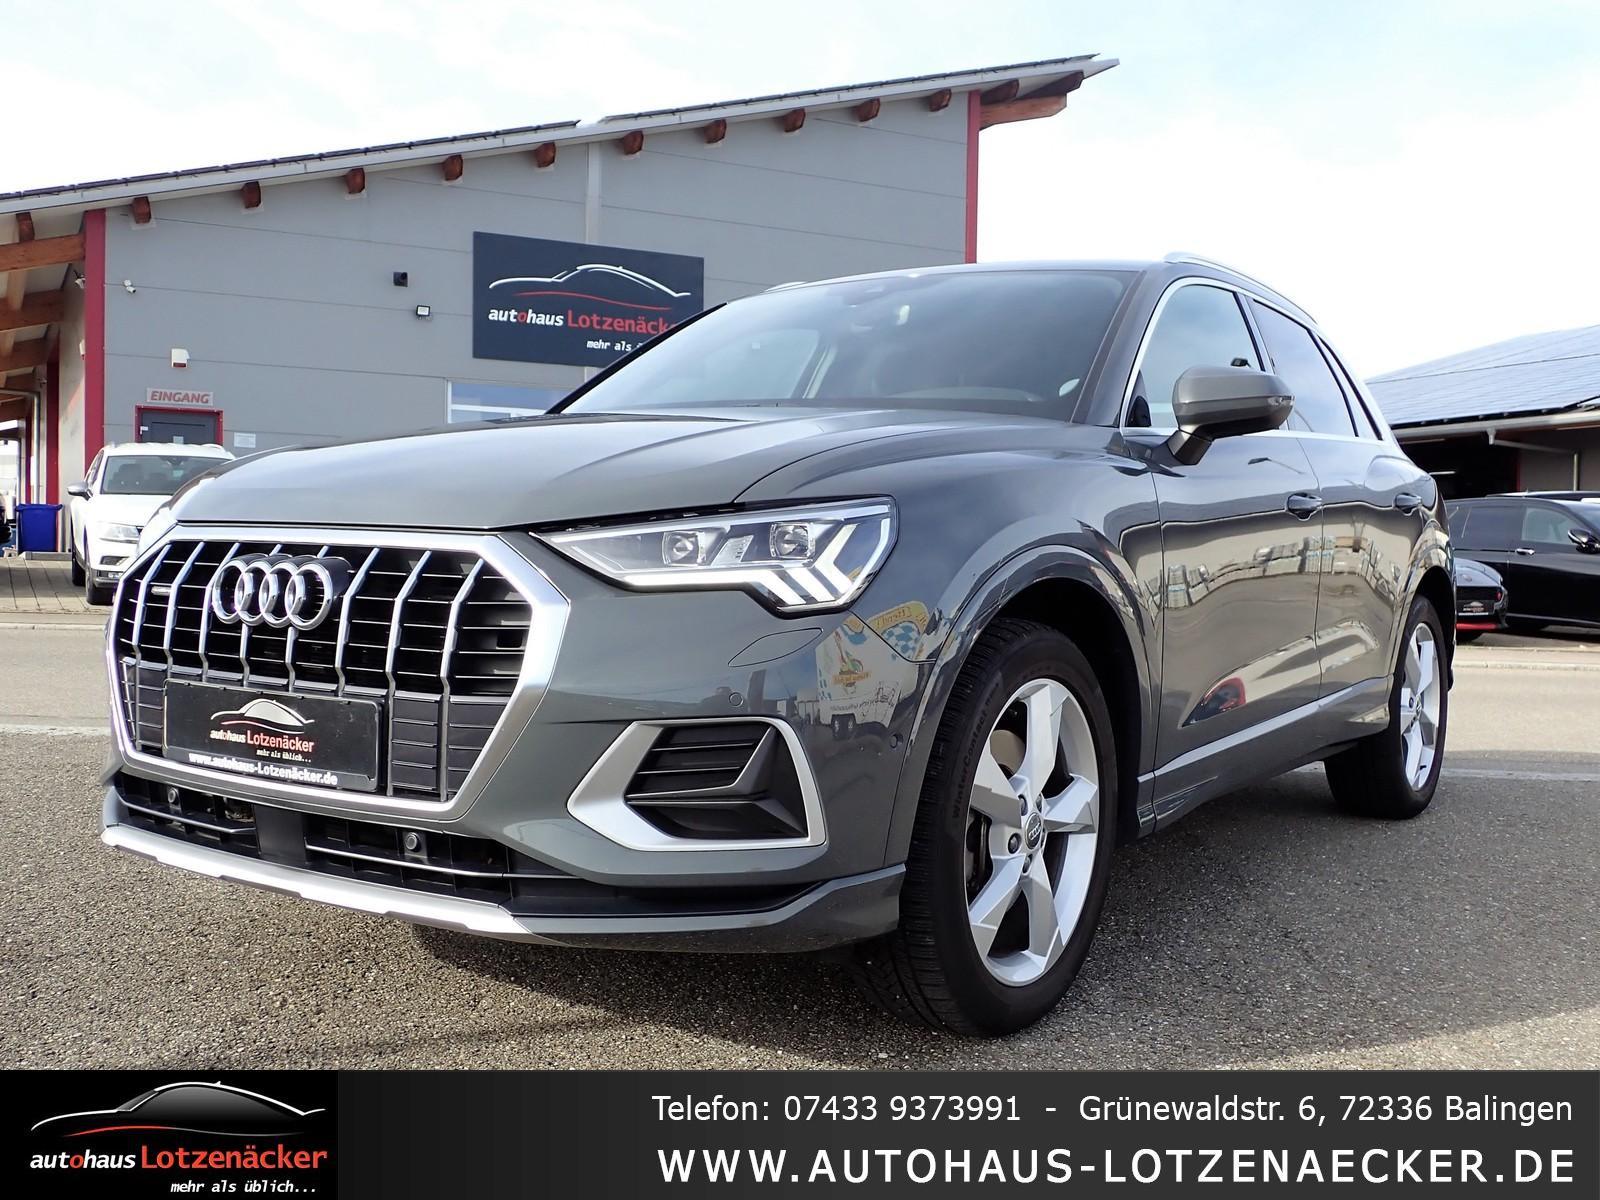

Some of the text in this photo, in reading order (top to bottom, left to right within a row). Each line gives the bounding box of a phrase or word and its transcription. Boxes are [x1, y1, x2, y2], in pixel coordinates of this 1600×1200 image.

[488, 308, 677, 335] autohaus Lotzenäck
[587, 339, 611, 350] mehr
[614, 341, 632, 352] als
[150, 390, 210, 404] EINGANG
[210, 729, 315, 752] autohaus Lotzenäcker
